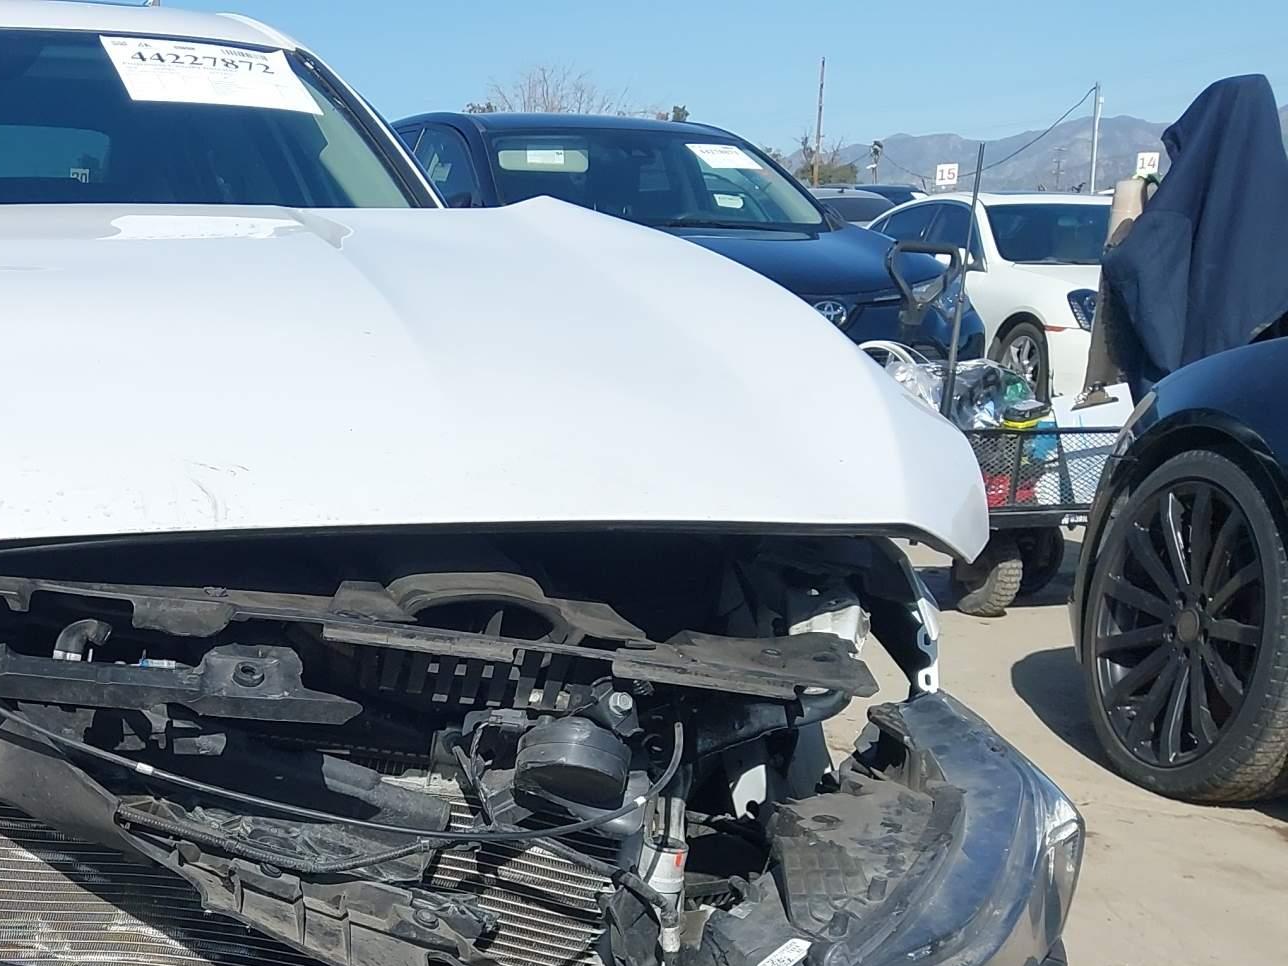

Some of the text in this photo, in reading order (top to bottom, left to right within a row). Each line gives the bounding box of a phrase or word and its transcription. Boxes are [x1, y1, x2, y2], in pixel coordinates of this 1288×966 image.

[130, 50, 275, 75] 44227872
[1138, 156, 1157, 170] 14
[938, 167, 956, 181] 15
